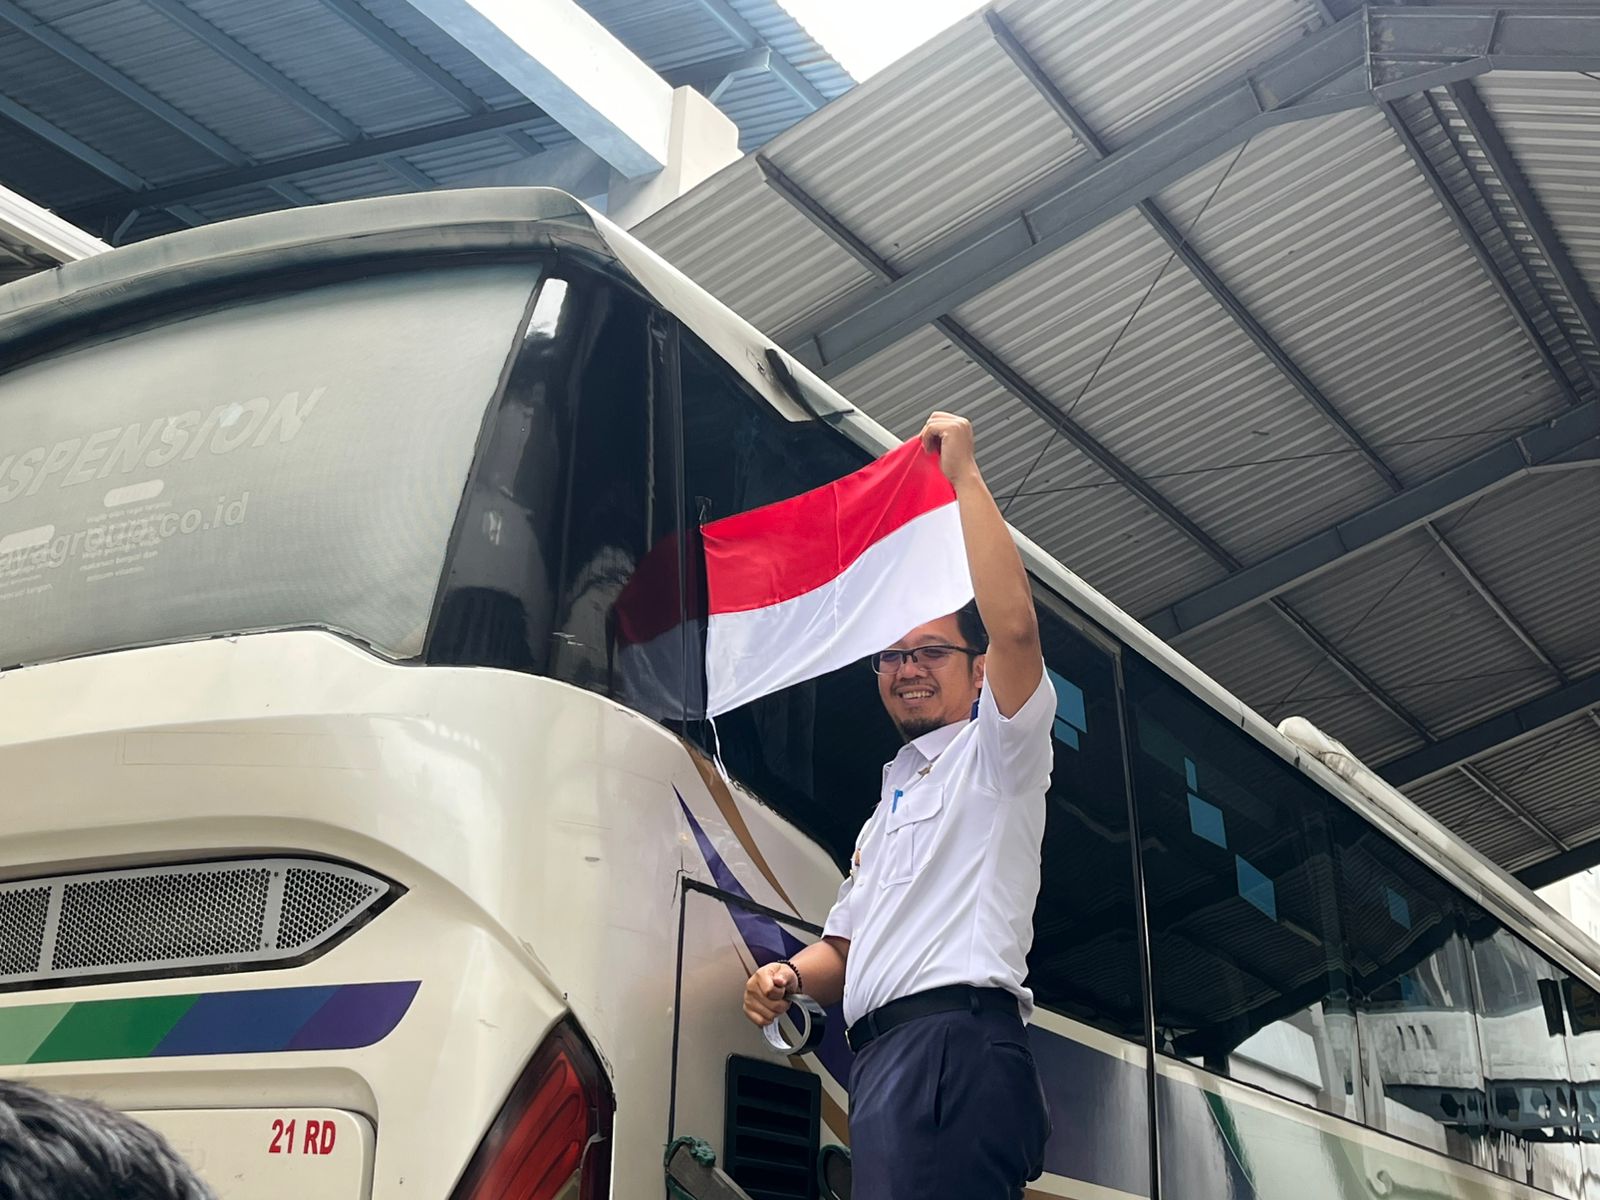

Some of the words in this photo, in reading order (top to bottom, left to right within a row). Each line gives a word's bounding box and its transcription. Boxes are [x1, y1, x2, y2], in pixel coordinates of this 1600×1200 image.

[268, 1118, 296, 1154] 21
[303, 1119, 337, 1155] RD
[1498, 1130, 1517, 1164] AIR
